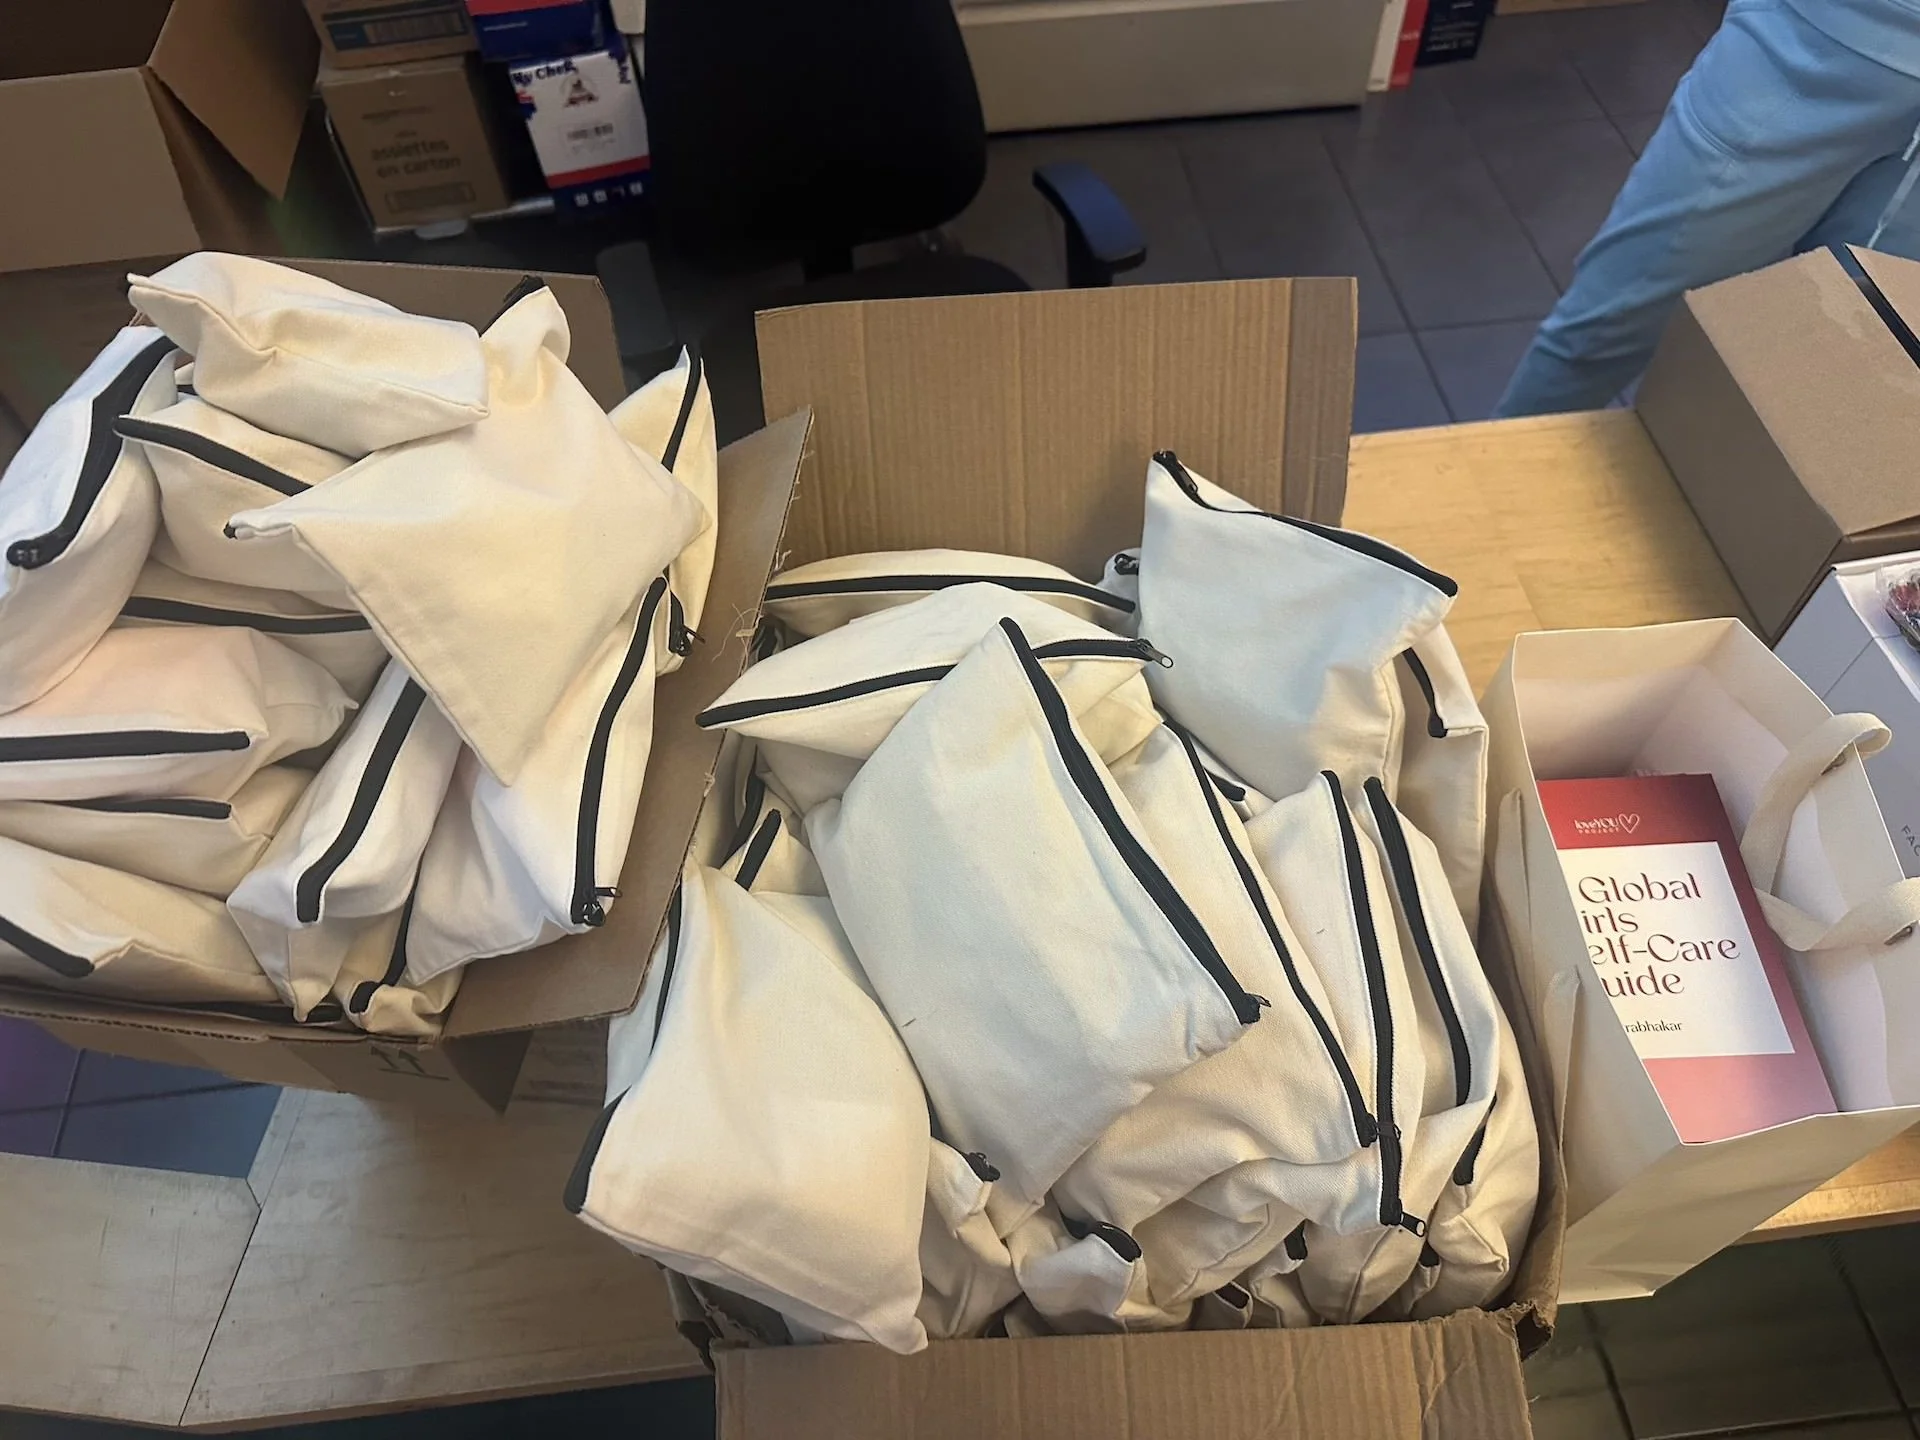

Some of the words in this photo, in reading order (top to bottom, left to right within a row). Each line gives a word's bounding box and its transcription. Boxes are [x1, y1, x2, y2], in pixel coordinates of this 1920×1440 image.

[1578, 872, 1702, 904] Global
[1580, 906, 1639, 934] irls
[1588, 933, 1741, 965] elf-Care
[1600, 964, 1685, 998] uide
[1625, 1018, 1683, 1034] rabhakar
